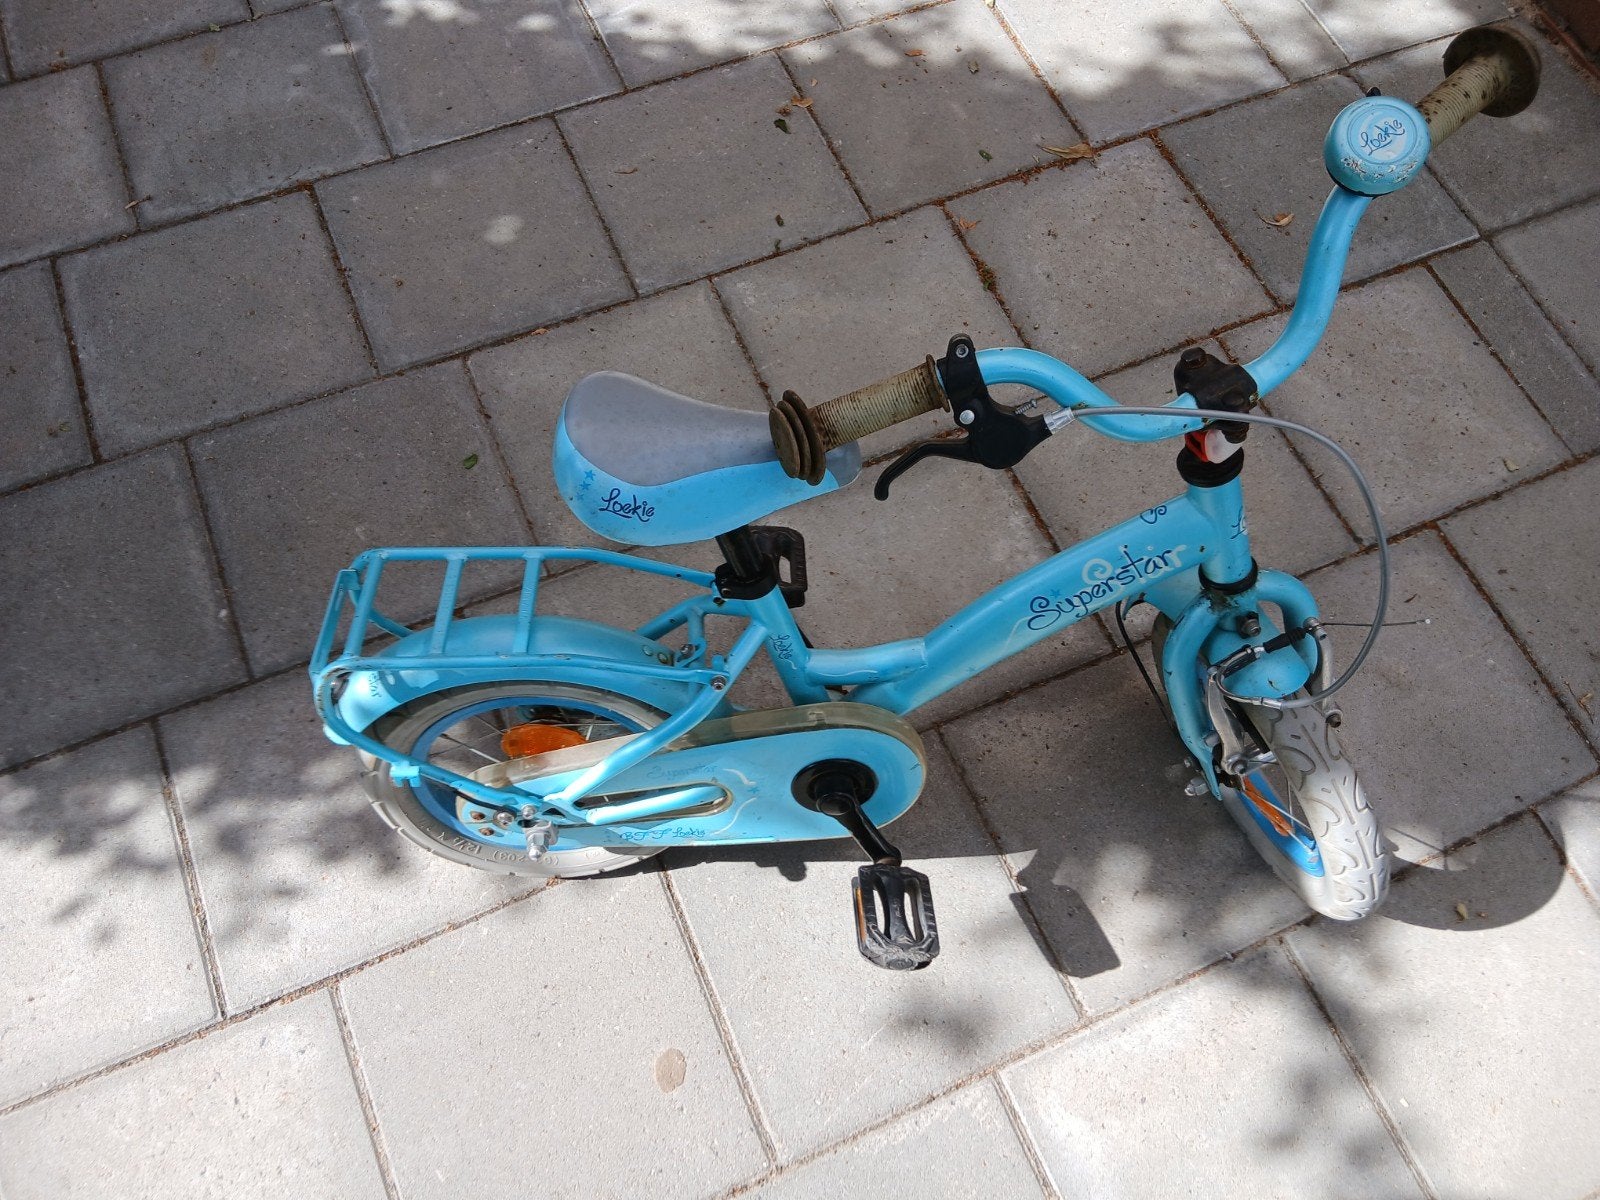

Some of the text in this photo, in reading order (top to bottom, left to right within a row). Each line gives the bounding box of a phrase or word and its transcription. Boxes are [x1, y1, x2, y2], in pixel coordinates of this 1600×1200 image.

[1360, 119, 1406, 156] Loekie
[598, 487, 656, 523] Loekie
[1027, 546, 1174, 631] Superstar
